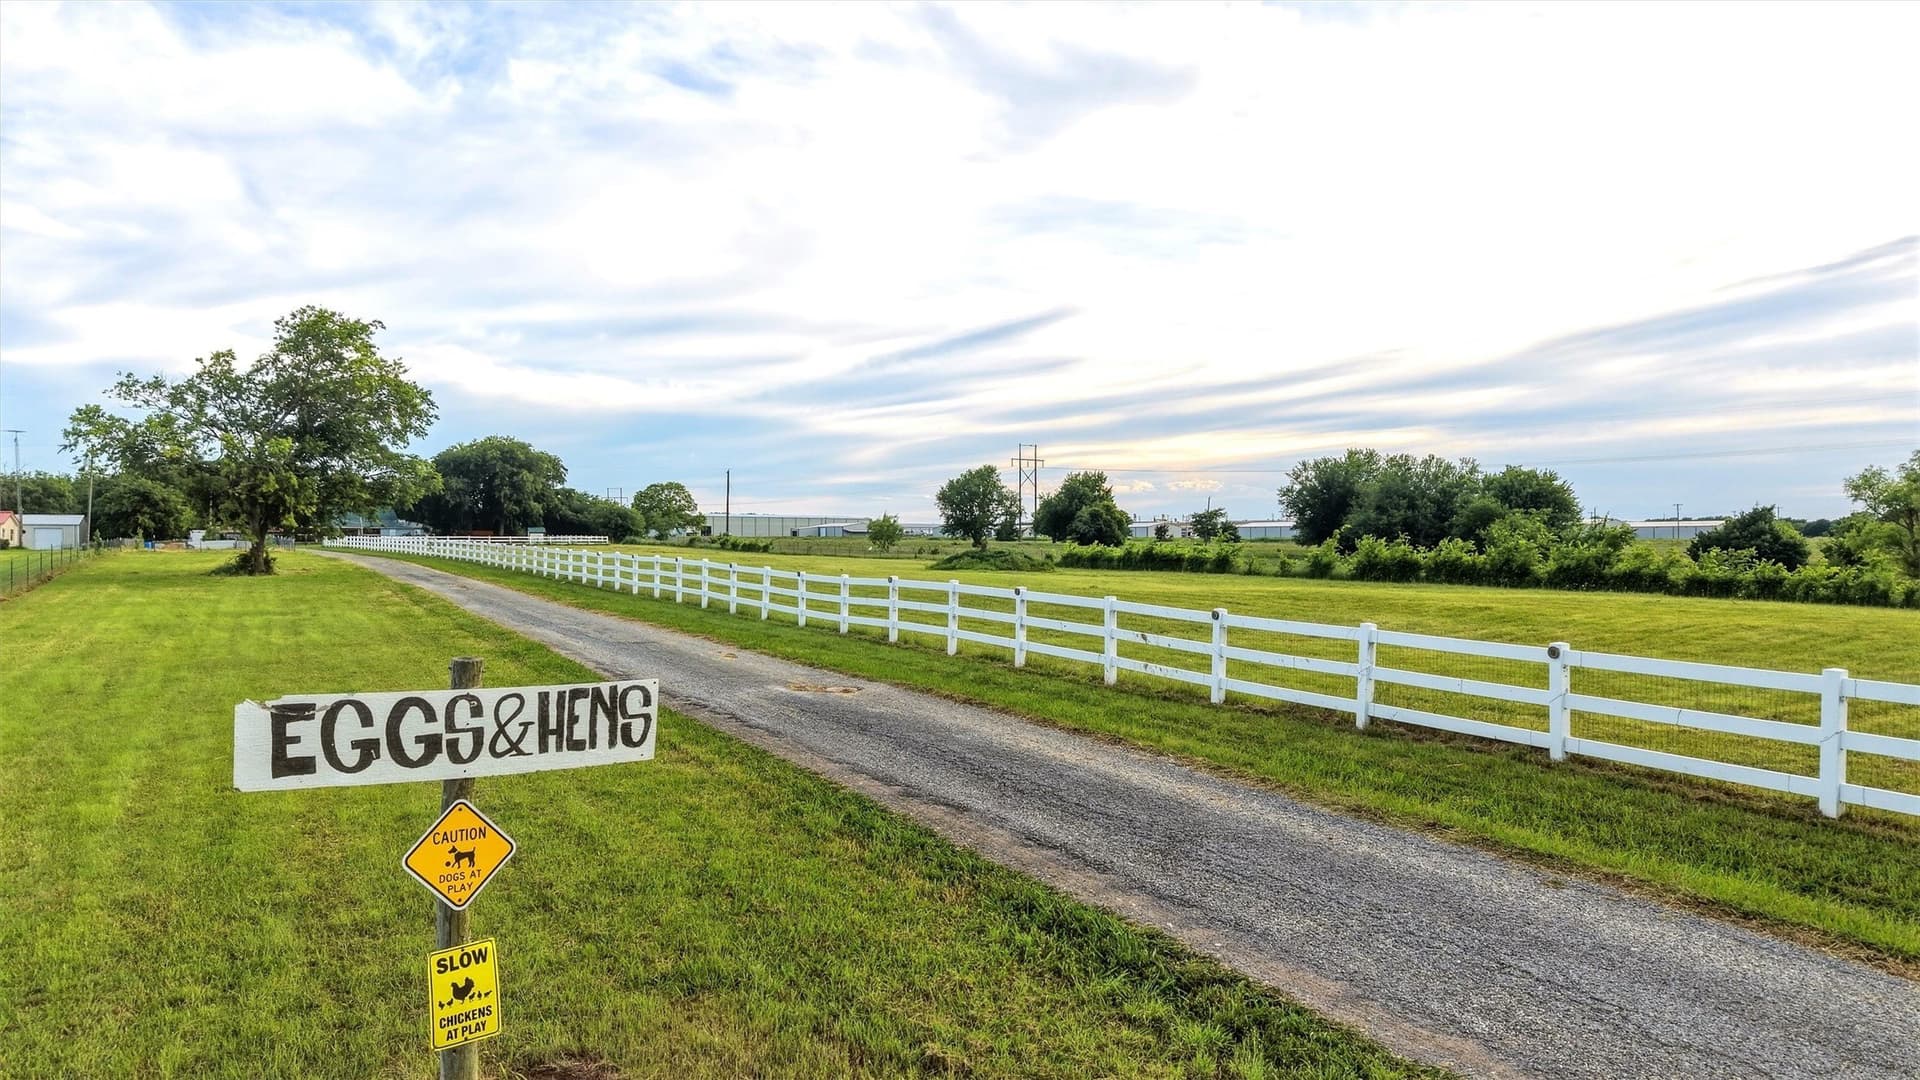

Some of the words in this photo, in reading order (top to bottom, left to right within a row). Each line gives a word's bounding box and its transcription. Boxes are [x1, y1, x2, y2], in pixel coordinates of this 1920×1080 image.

[433, 827, 486, 845] CAUTION
[439, 872, 466, 884] DOGS
[469, 869, 482, 879] AT
[447, 882, 473, 894] PLAY
[436, 947, 488, 974] SLOW
[439, 1005, 492, 1029] CHICKENS
[446, 1028, 458, 1041] AT
[462, 1021, 487, 1037] PLAY
